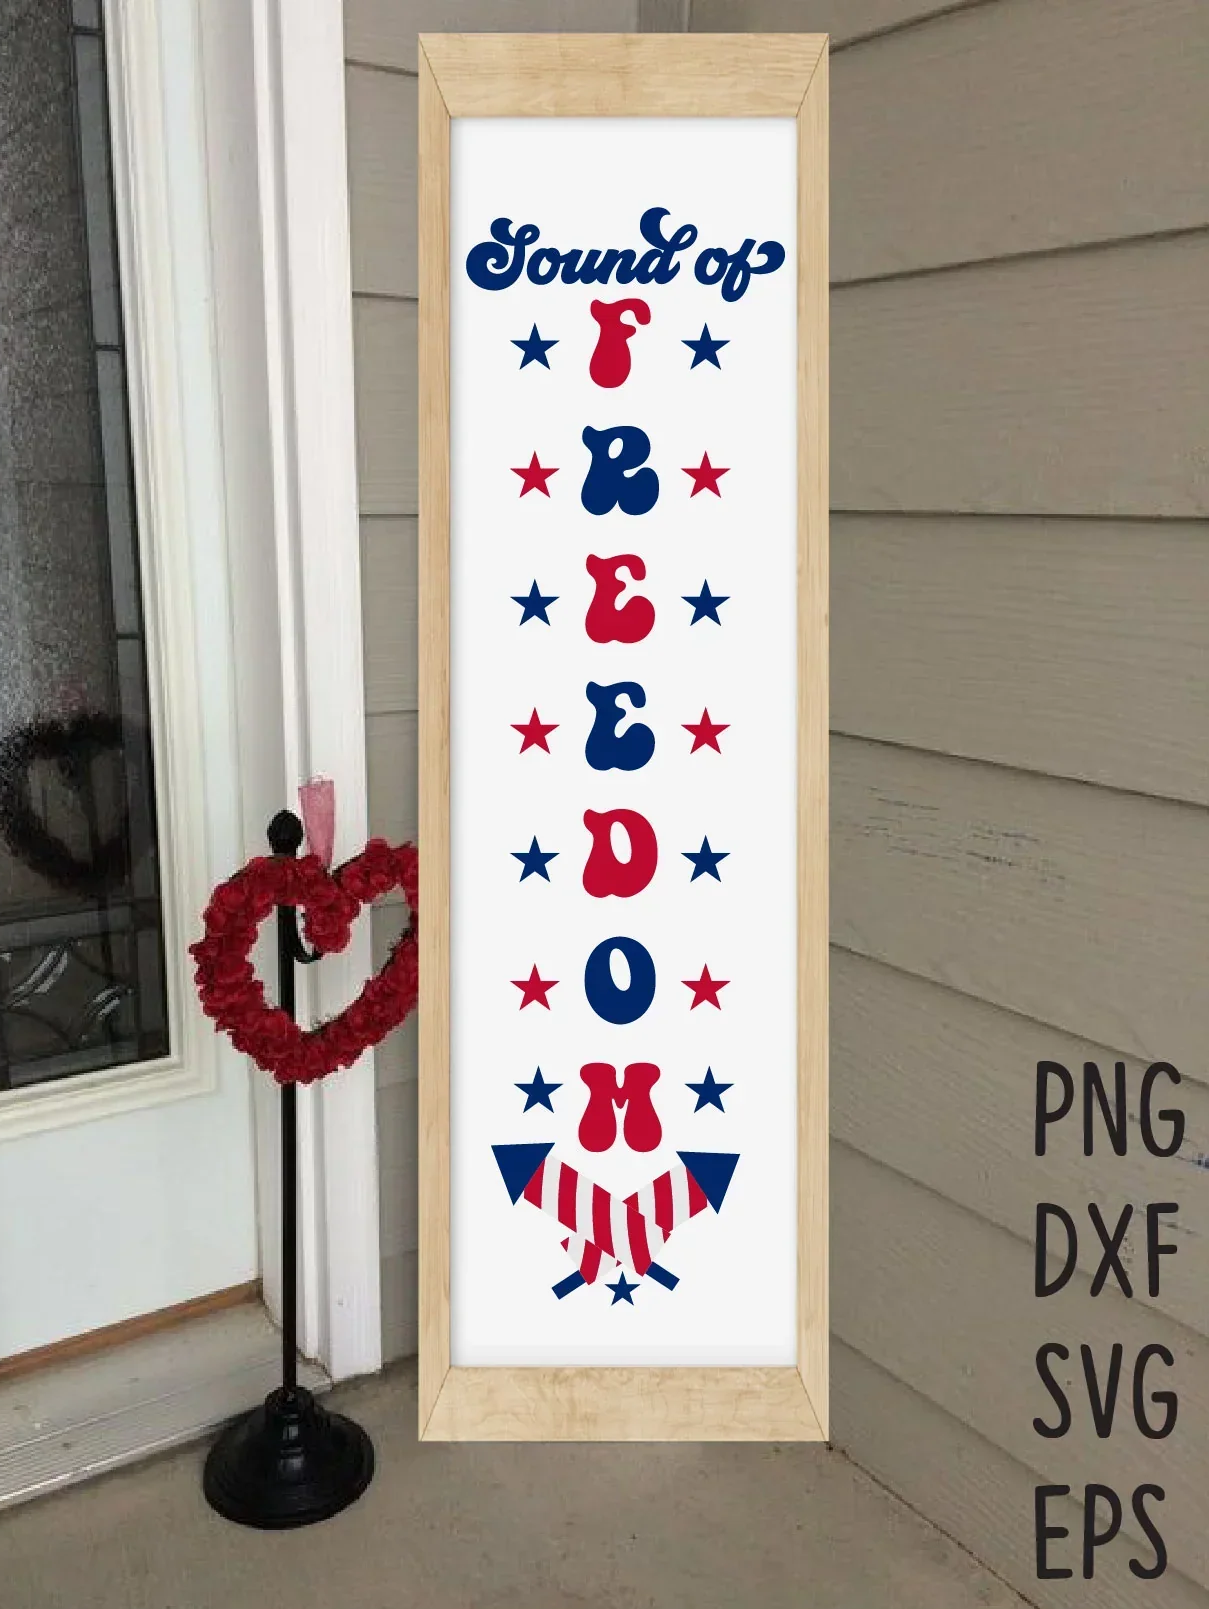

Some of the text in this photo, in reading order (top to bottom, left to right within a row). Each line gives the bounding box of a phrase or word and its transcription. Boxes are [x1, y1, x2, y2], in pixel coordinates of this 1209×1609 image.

[466, 207, 786, 302] Sound of
[577, 298, 663, 1153] FREEDOM
